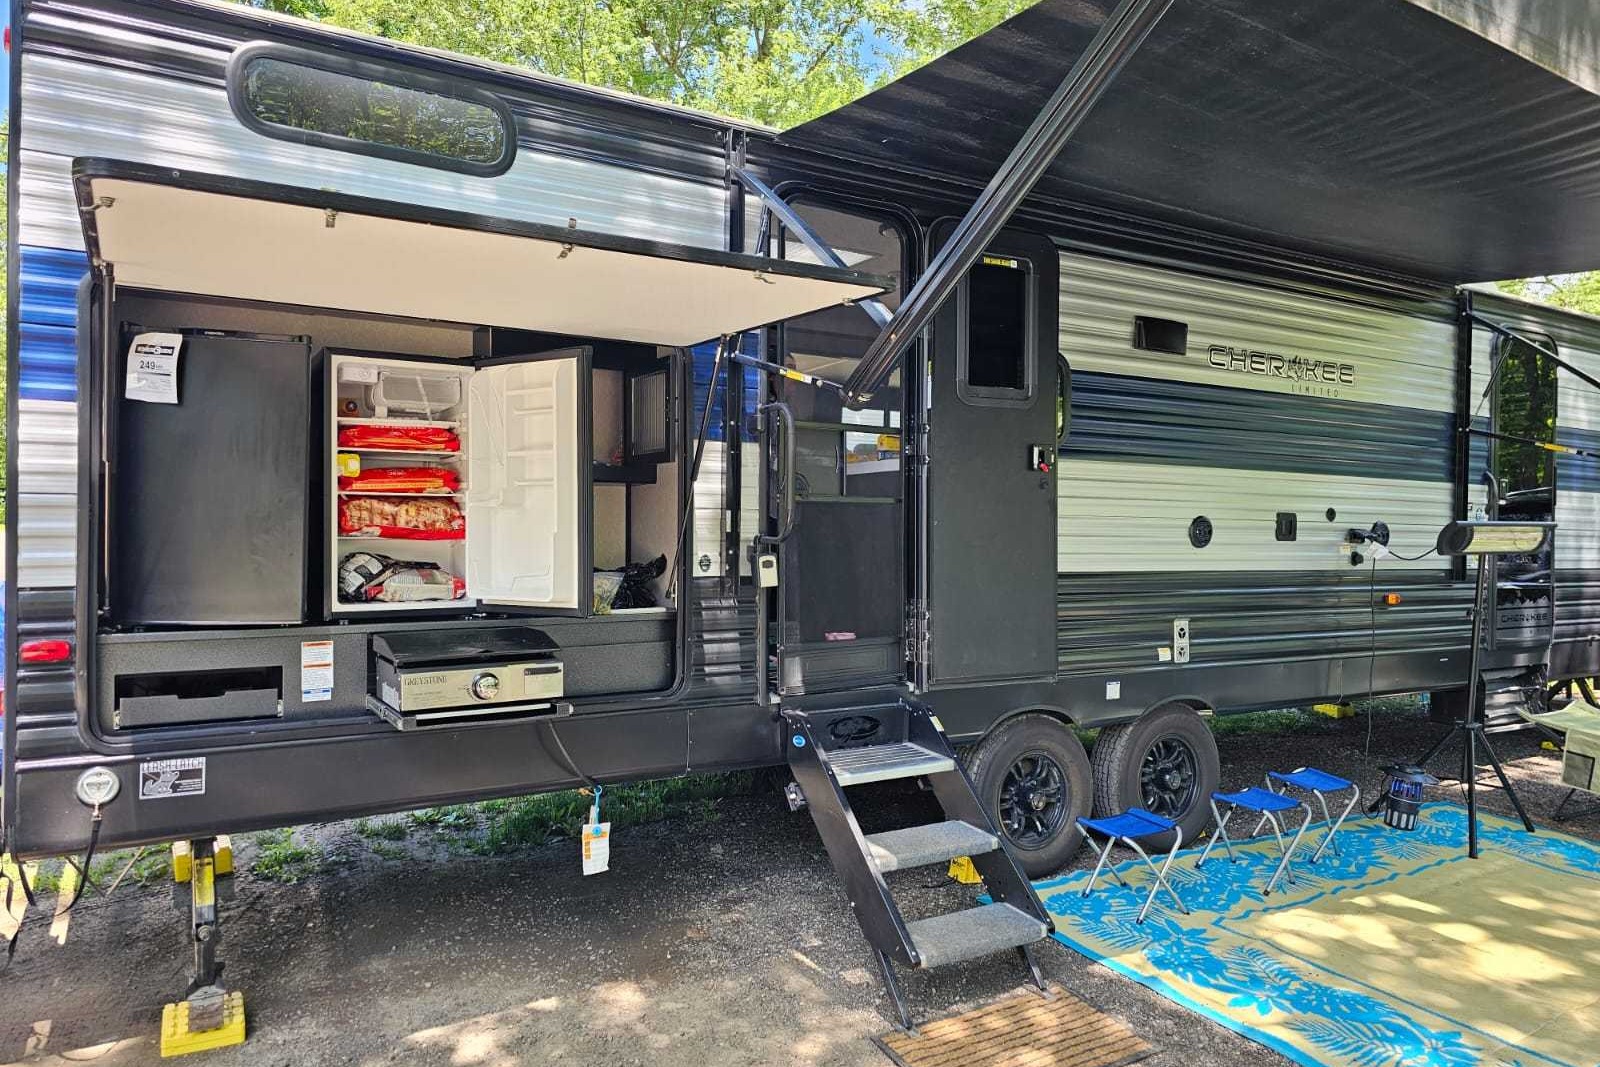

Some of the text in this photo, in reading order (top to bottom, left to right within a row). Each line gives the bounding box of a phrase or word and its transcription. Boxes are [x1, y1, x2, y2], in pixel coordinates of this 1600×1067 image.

[139, 360, 156, 370] 249
[1207, 344, 1355, 385] CHEROKEE
[1291, 384, 1340, 398] LIMITED
